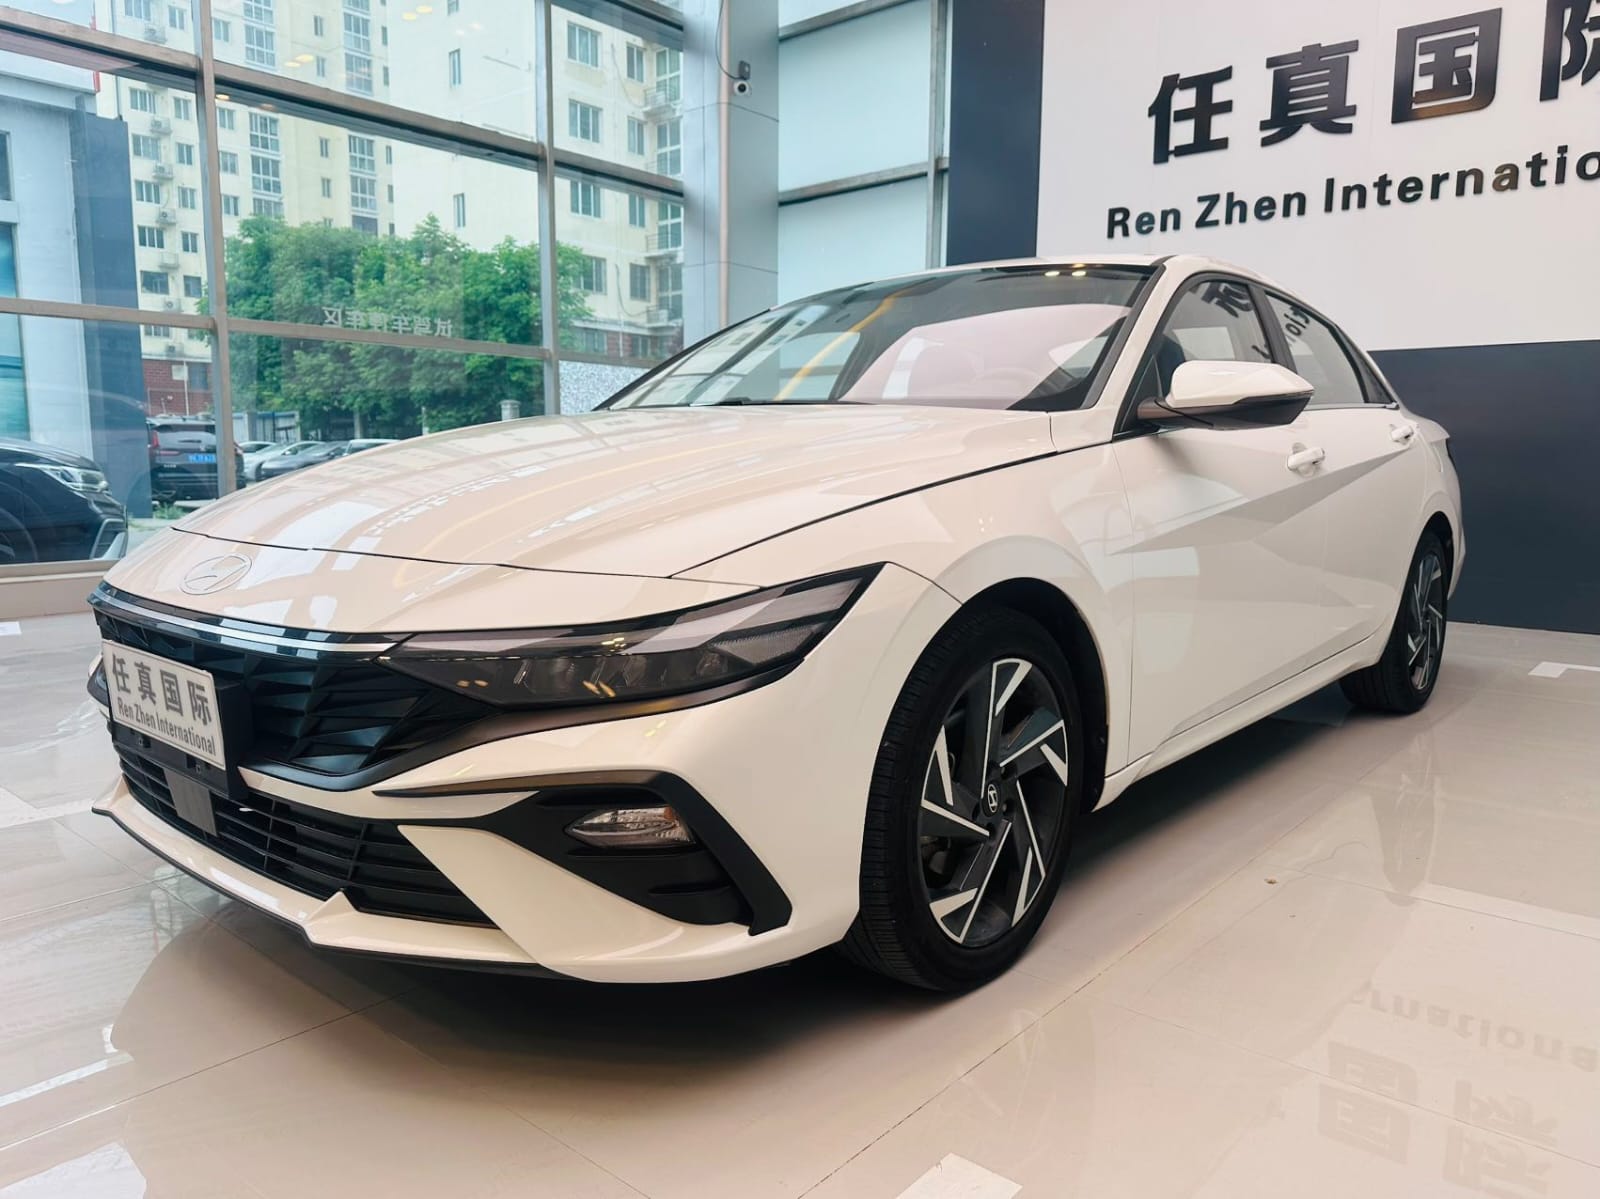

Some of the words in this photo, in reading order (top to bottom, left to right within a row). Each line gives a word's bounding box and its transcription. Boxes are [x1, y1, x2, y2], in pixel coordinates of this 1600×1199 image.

[1107, 206, 1181, 238] Ren
[1195, 191, 1307, 229] Zhen
[112, 653, 213, 726] 任真国际
[117, 697, 134, 720] Ren
[134, 703, 157, 730] Zhen
[156, 711, 217, 757] International
